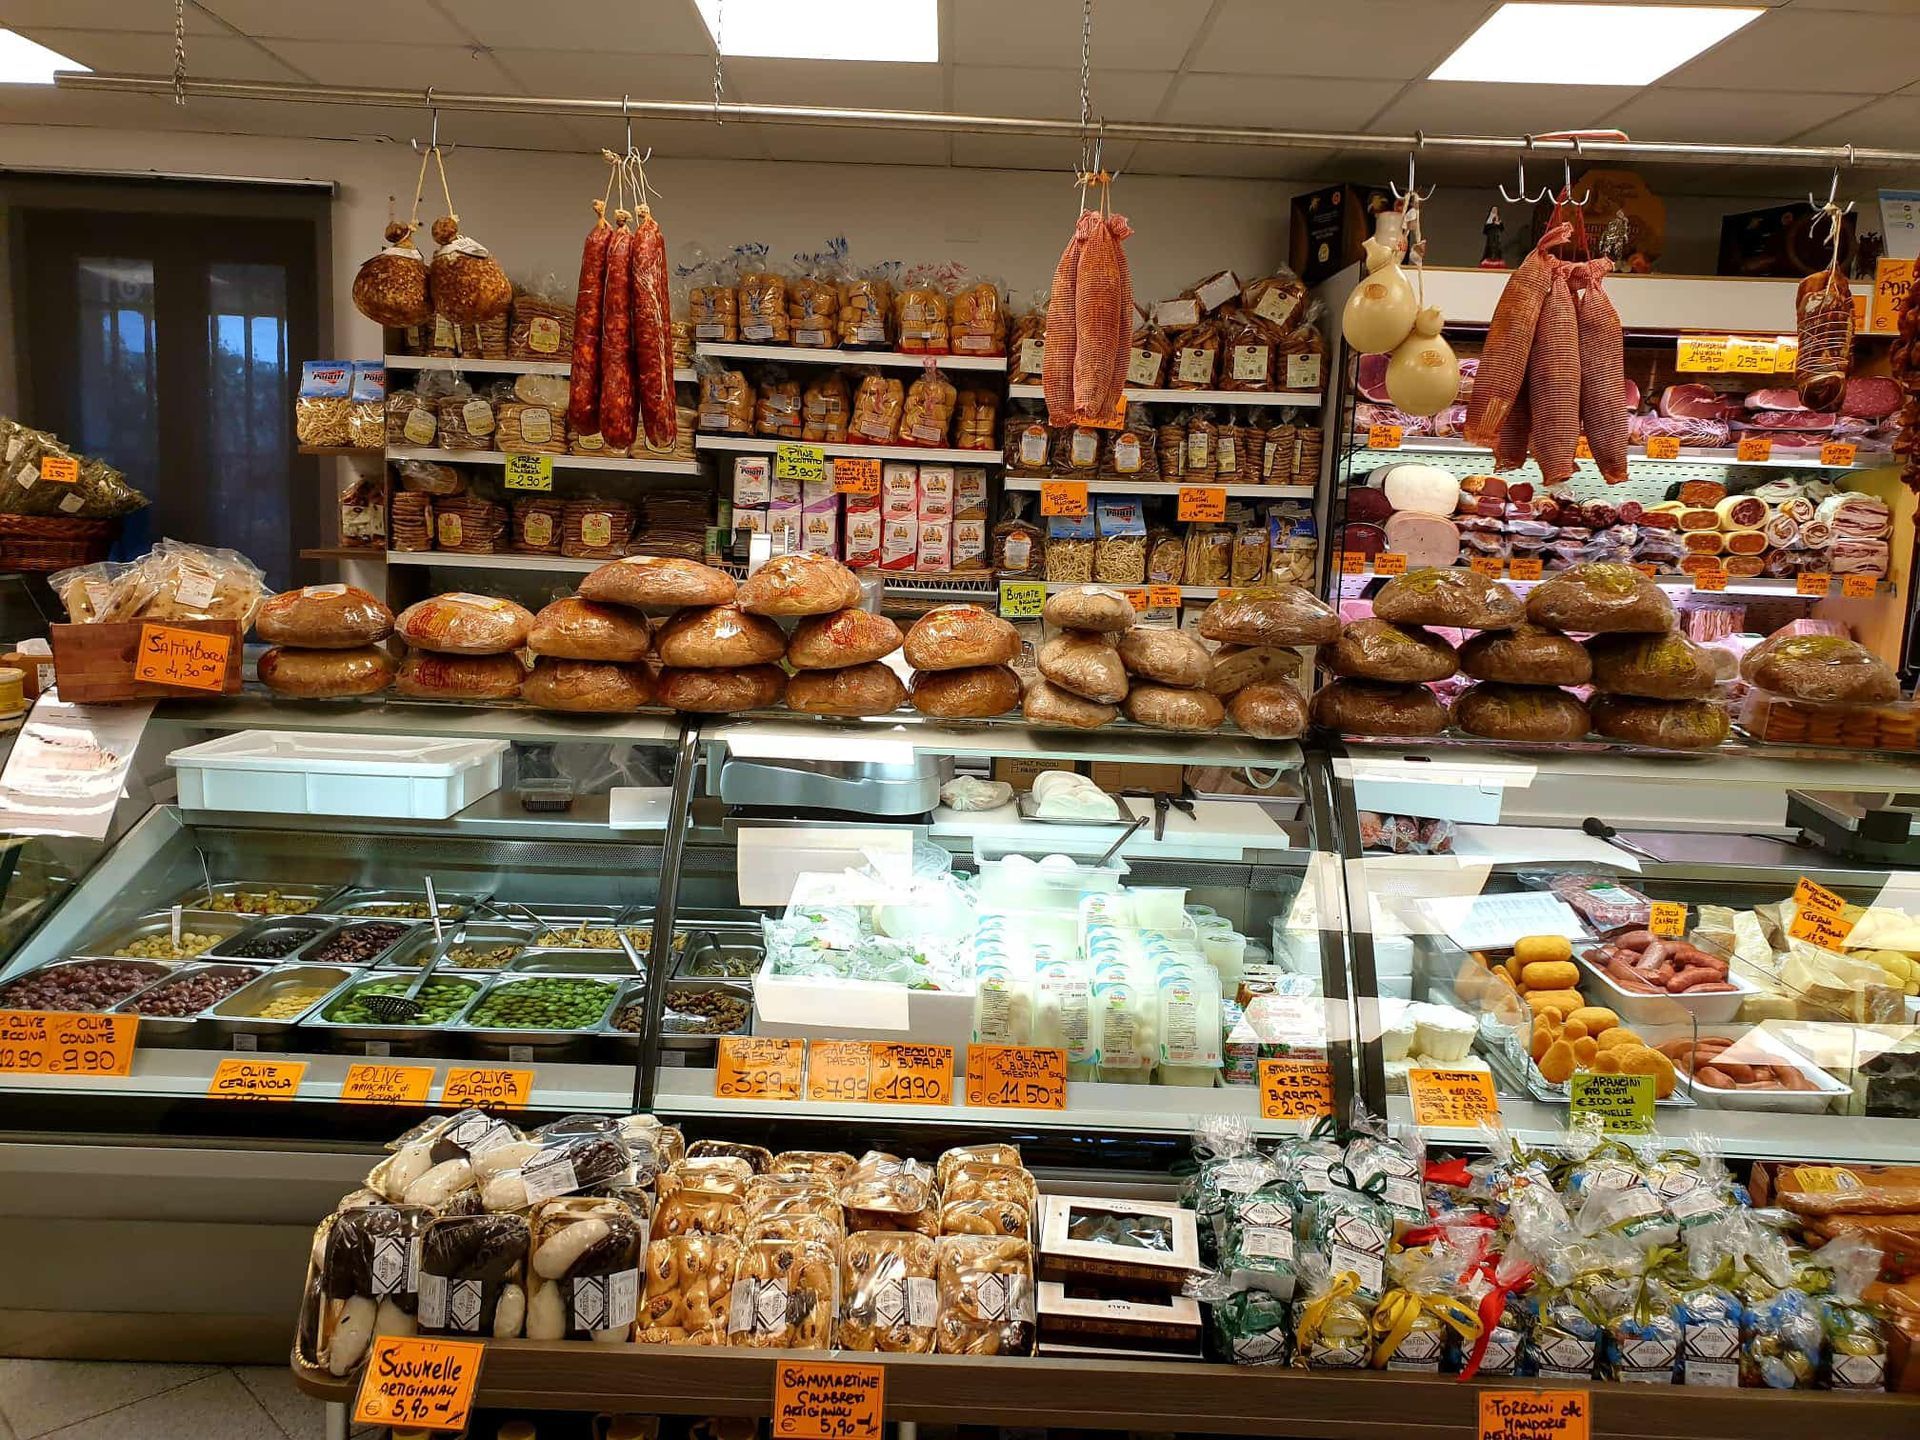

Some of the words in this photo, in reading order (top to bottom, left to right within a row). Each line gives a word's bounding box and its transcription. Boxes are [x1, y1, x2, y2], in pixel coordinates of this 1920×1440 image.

[9, 1015, 46, 1028] OLIVE
[77, 1017, 115, 1030] OLIVE
[60, 1031, 116, 1044] CONDITE
[899, 1057, 944, 1069] BUFALA
[1009, 1060, 1049, 1071] BUFALA
[240, 1066, 278, 1077] OLIVE
[361, 1066, 406, 1083] OLIVE
[470, 1070, 514, 1084] OLIVE
[1432, 1071, 1480, 1082] RICOTTA
[219, 1077, 292, 1090] CERIGNOLA
[1592, 1076, 1642, 1088] ARANCINI
[448, 1082, 518, 1097] SALAMOIA
[1268, 1089, 1323, 1101] BURRATA
[783, 1368, 880, 1389] SAMMARTINE
